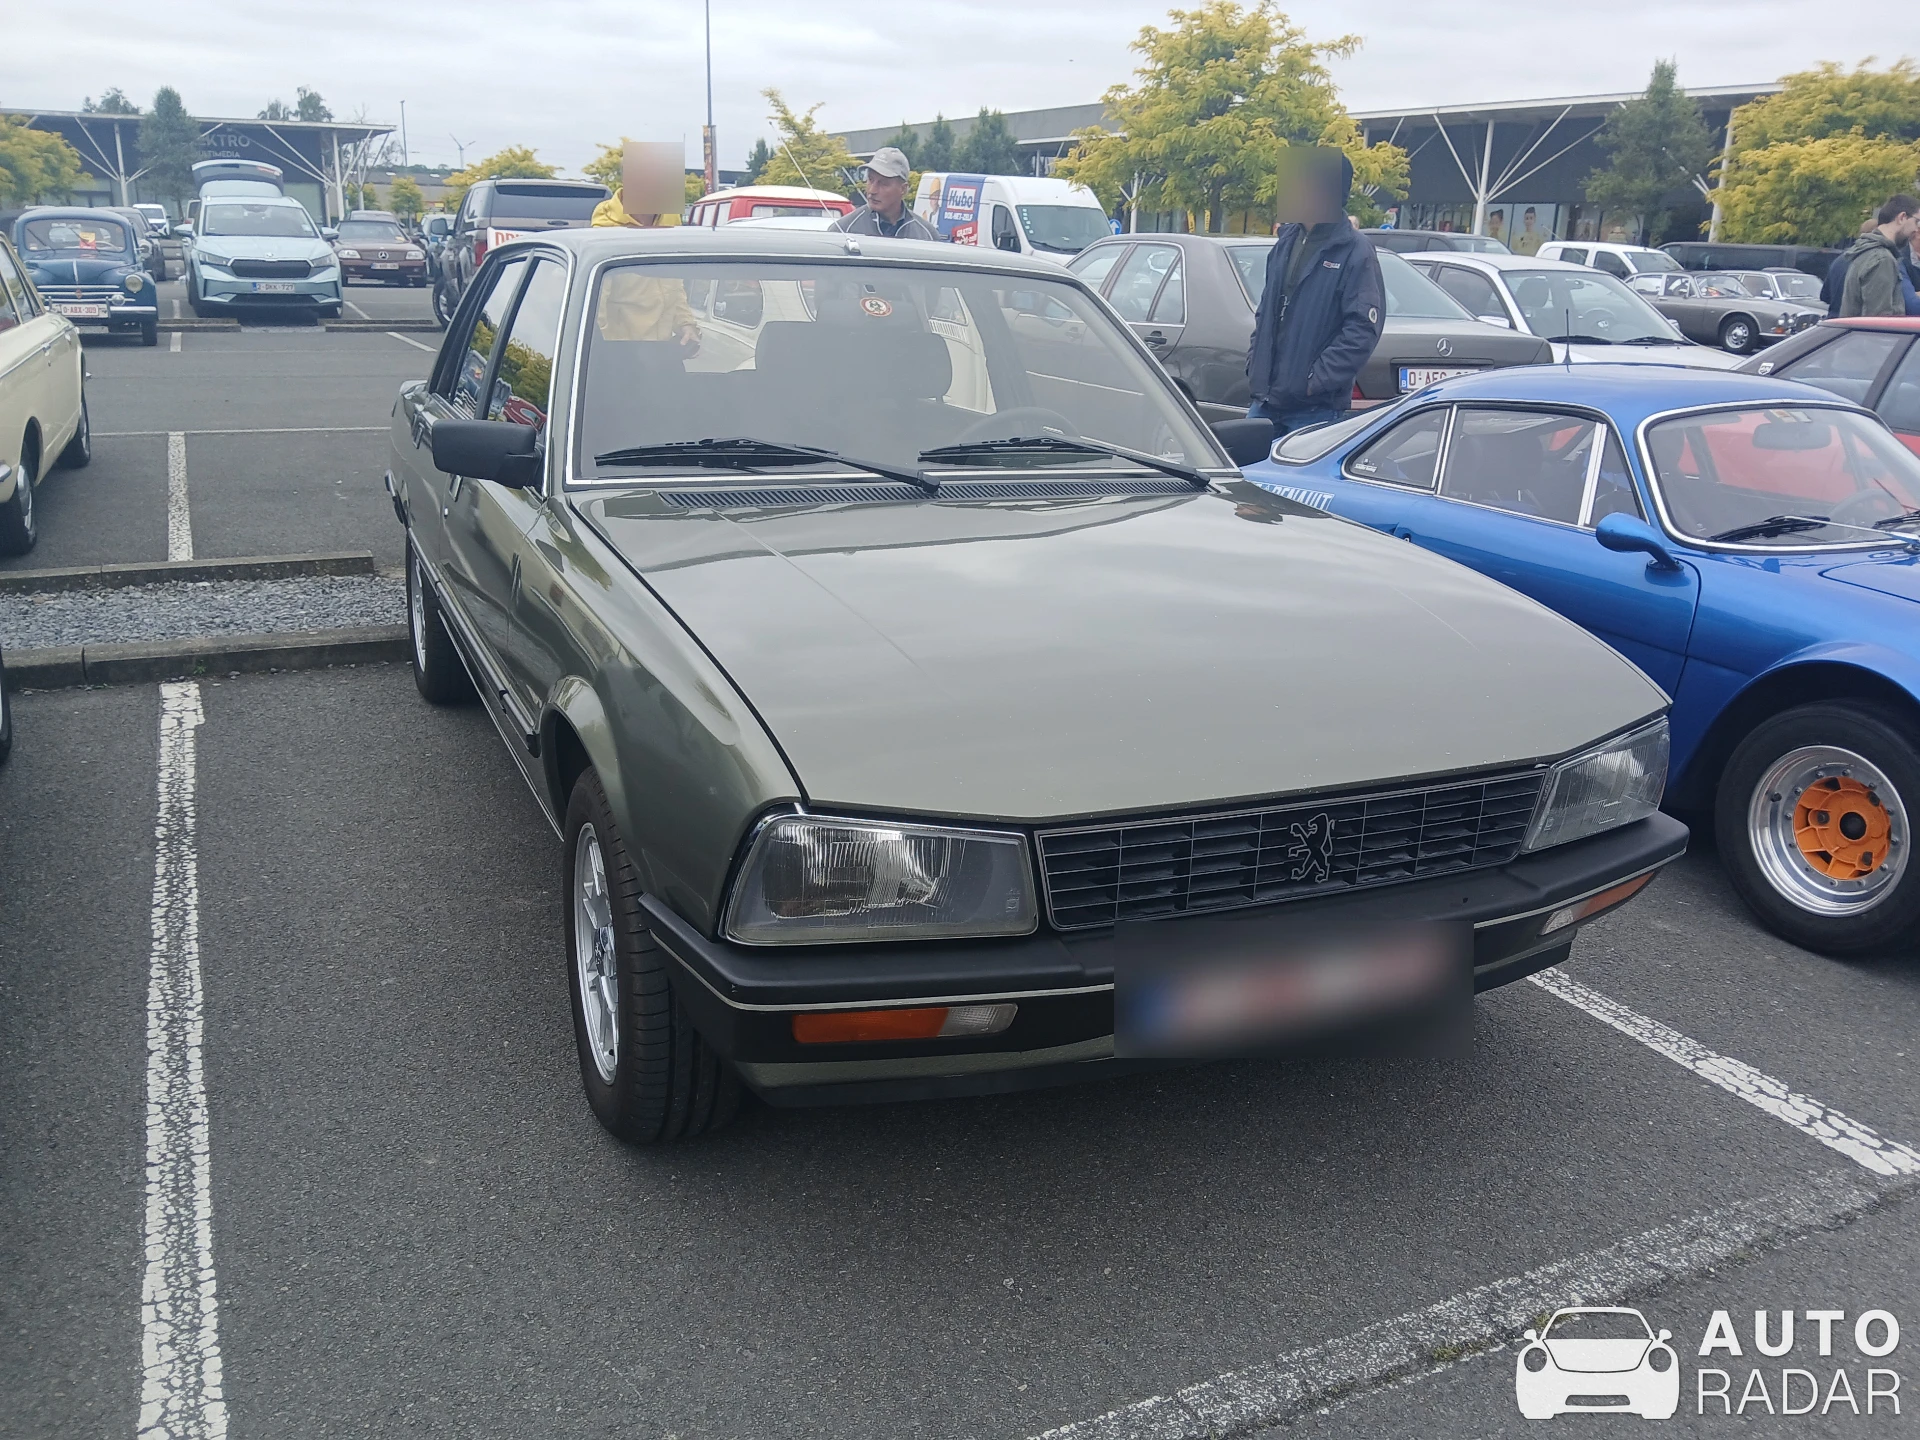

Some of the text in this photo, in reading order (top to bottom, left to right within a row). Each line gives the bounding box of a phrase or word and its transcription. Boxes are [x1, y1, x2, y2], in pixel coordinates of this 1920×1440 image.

[196, 150, 241, 158] ULTIMEDIA
[949, 190, 973, 208] Hubo
[1401, 380, 1407, 388] B
